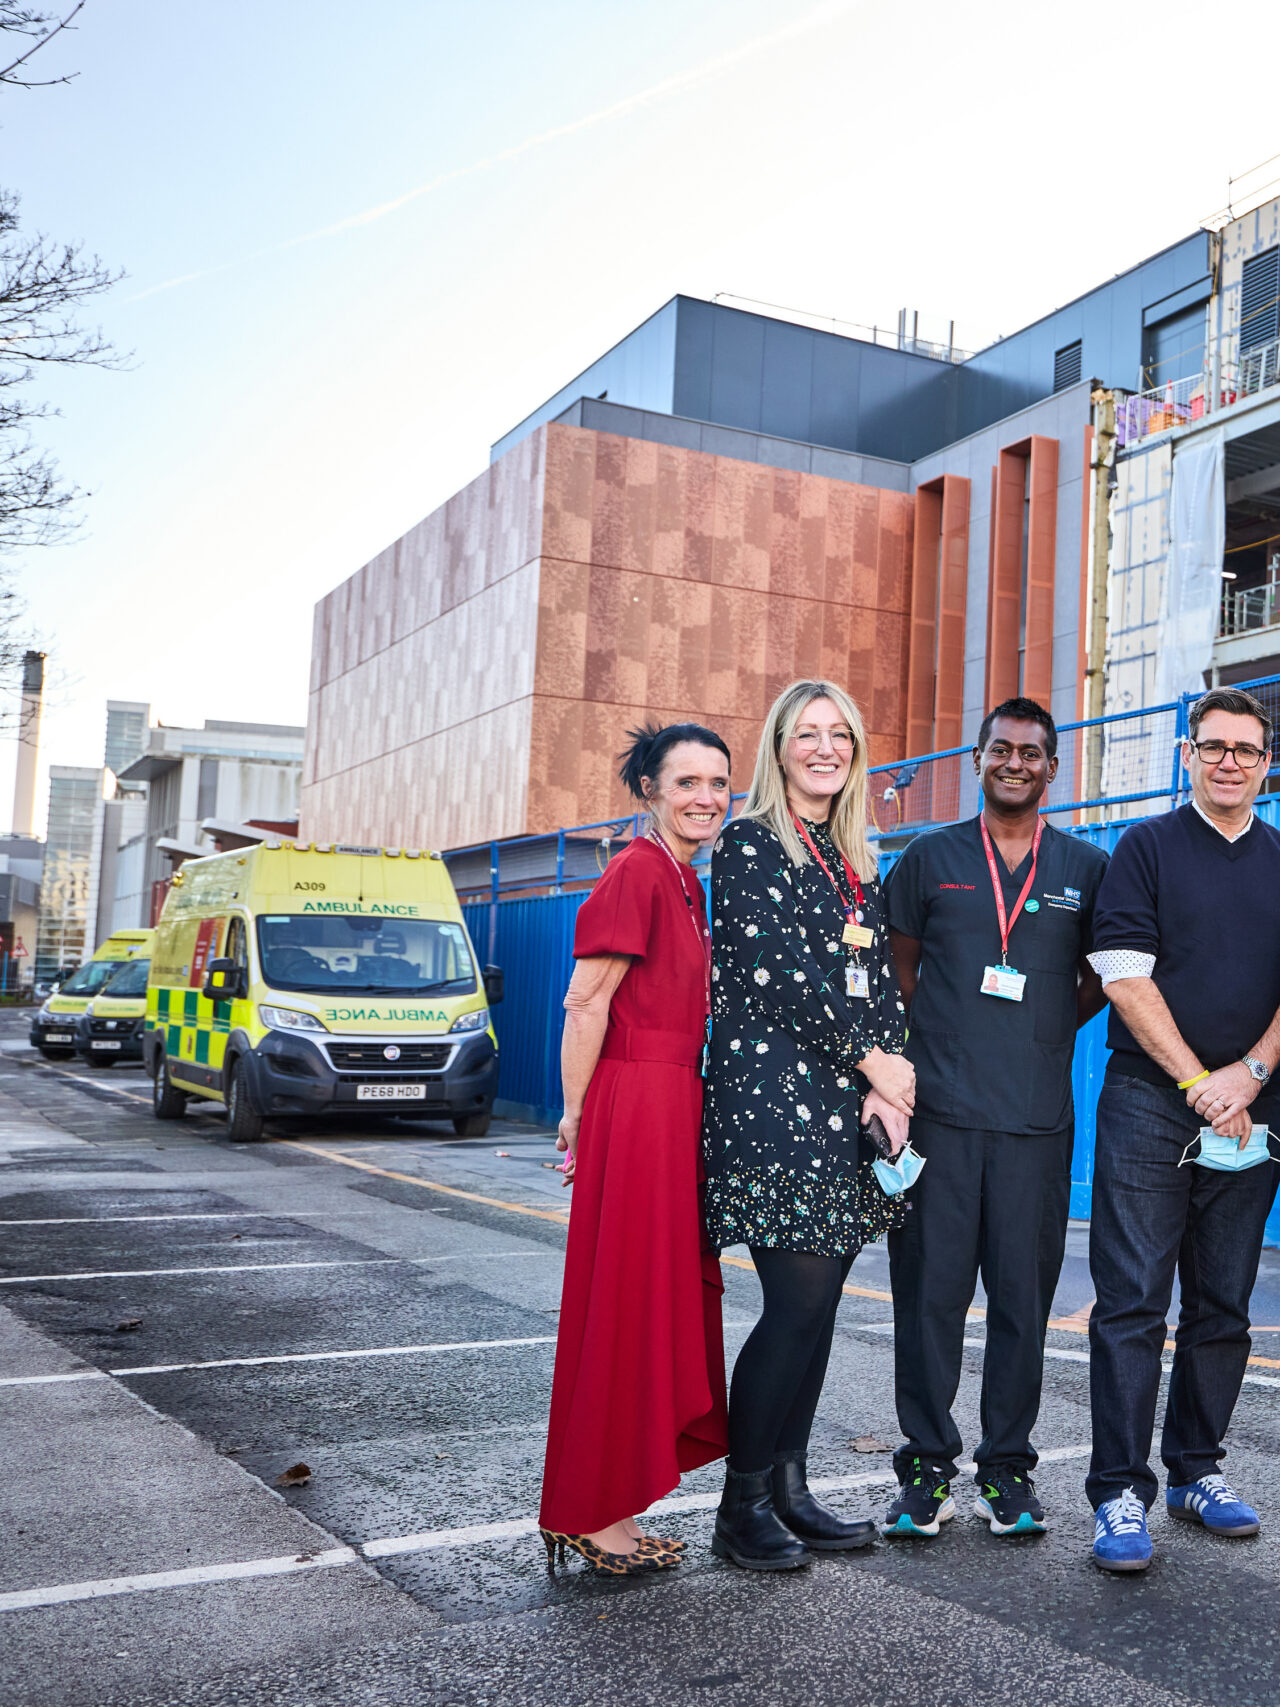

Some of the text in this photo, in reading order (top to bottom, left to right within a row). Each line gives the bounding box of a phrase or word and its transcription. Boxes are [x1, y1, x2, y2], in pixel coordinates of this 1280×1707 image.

[339, 847, 378, 855] AMBULANCE
[294, 881, 326, 892] A309
[940, 883, 976, 891] CONSULTANT
[1064, 889, 1080, 898] NHS
[303, 902, 419, 917] AMBULANCE
[363, 1087, 394, 1097] PE68
